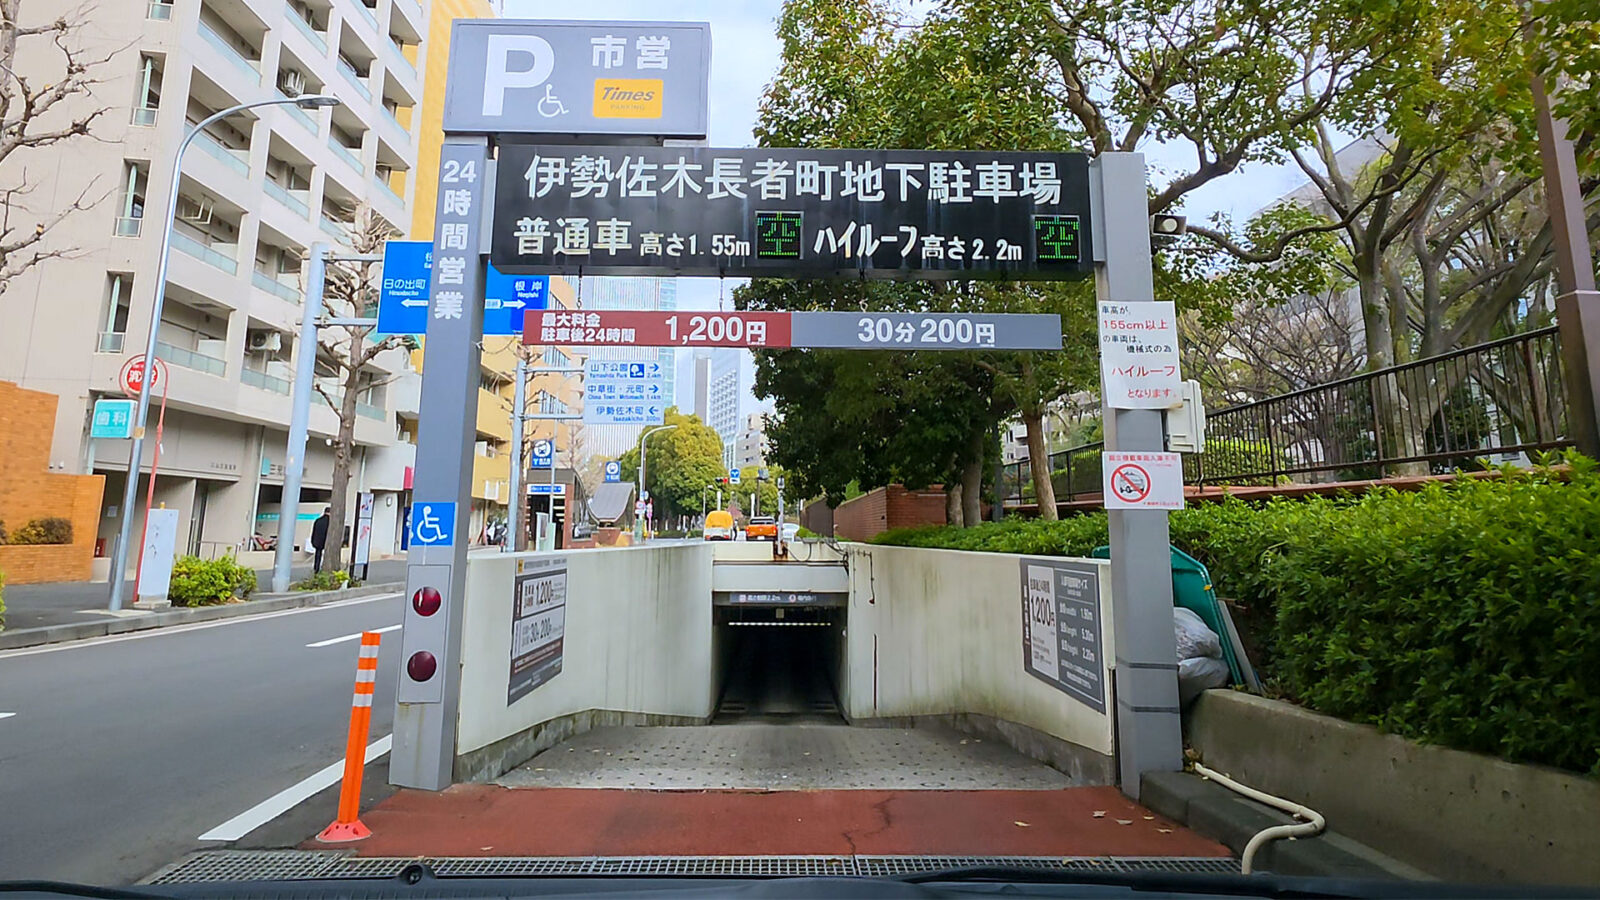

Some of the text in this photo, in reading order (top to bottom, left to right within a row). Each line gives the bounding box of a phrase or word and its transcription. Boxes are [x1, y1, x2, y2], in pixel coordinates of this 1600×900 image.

[591, 35, 671, 70] 市営
[482, 34, 555, 116] P
[602, 86, 655, 101] Times
[524, 154, 1062, 205] 伊勢佐木長者町地下駐車場
[434, 160, 477, 320] 24時間営業
[513, 216, 632, 257] 普通車
[757, 212, 801, 257] 空
[814, 220, 917, 258] ハイルーフ
[1035, 216, 1079, 260] 空
[384, 278, 426, 289] 日の出町
[541, 312, 601, 328] 最大料金
[665, 315, 767, 346] 1,200円
[1103, 319, 1168, 331] 155cm以上
[540, 328, 636, 344] 駐車後24時間
[1112, 365, 1176, 377] ハイルーフ
[596, 406, 644, 415] 伊勢佐木町
